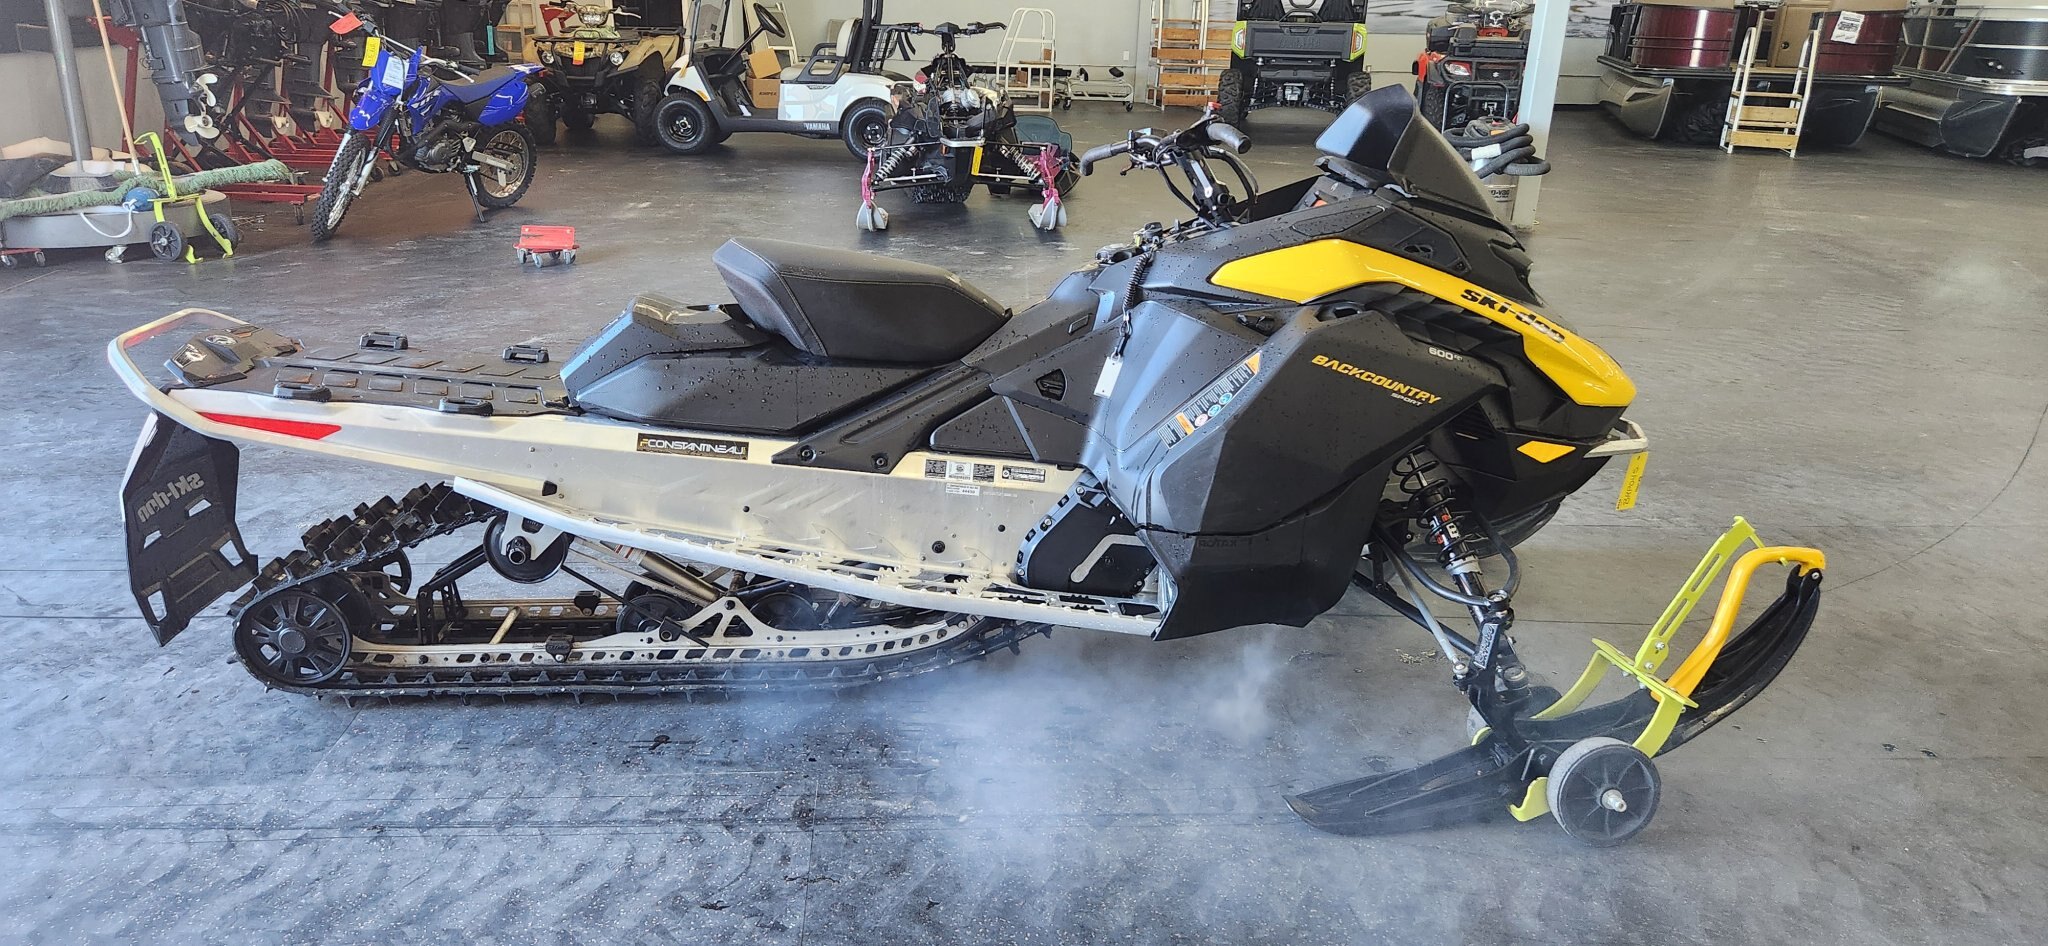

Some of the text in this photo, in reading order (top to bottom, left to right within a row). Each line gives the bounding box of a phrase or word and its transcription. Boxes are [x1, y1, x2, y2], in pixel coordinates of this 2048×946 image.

[804, 122, 831, 131] YAMAHA
[1311, 354, 1442, 404] BACKCOUNTRY
[1390, 392, 1424, 407] SPORT
